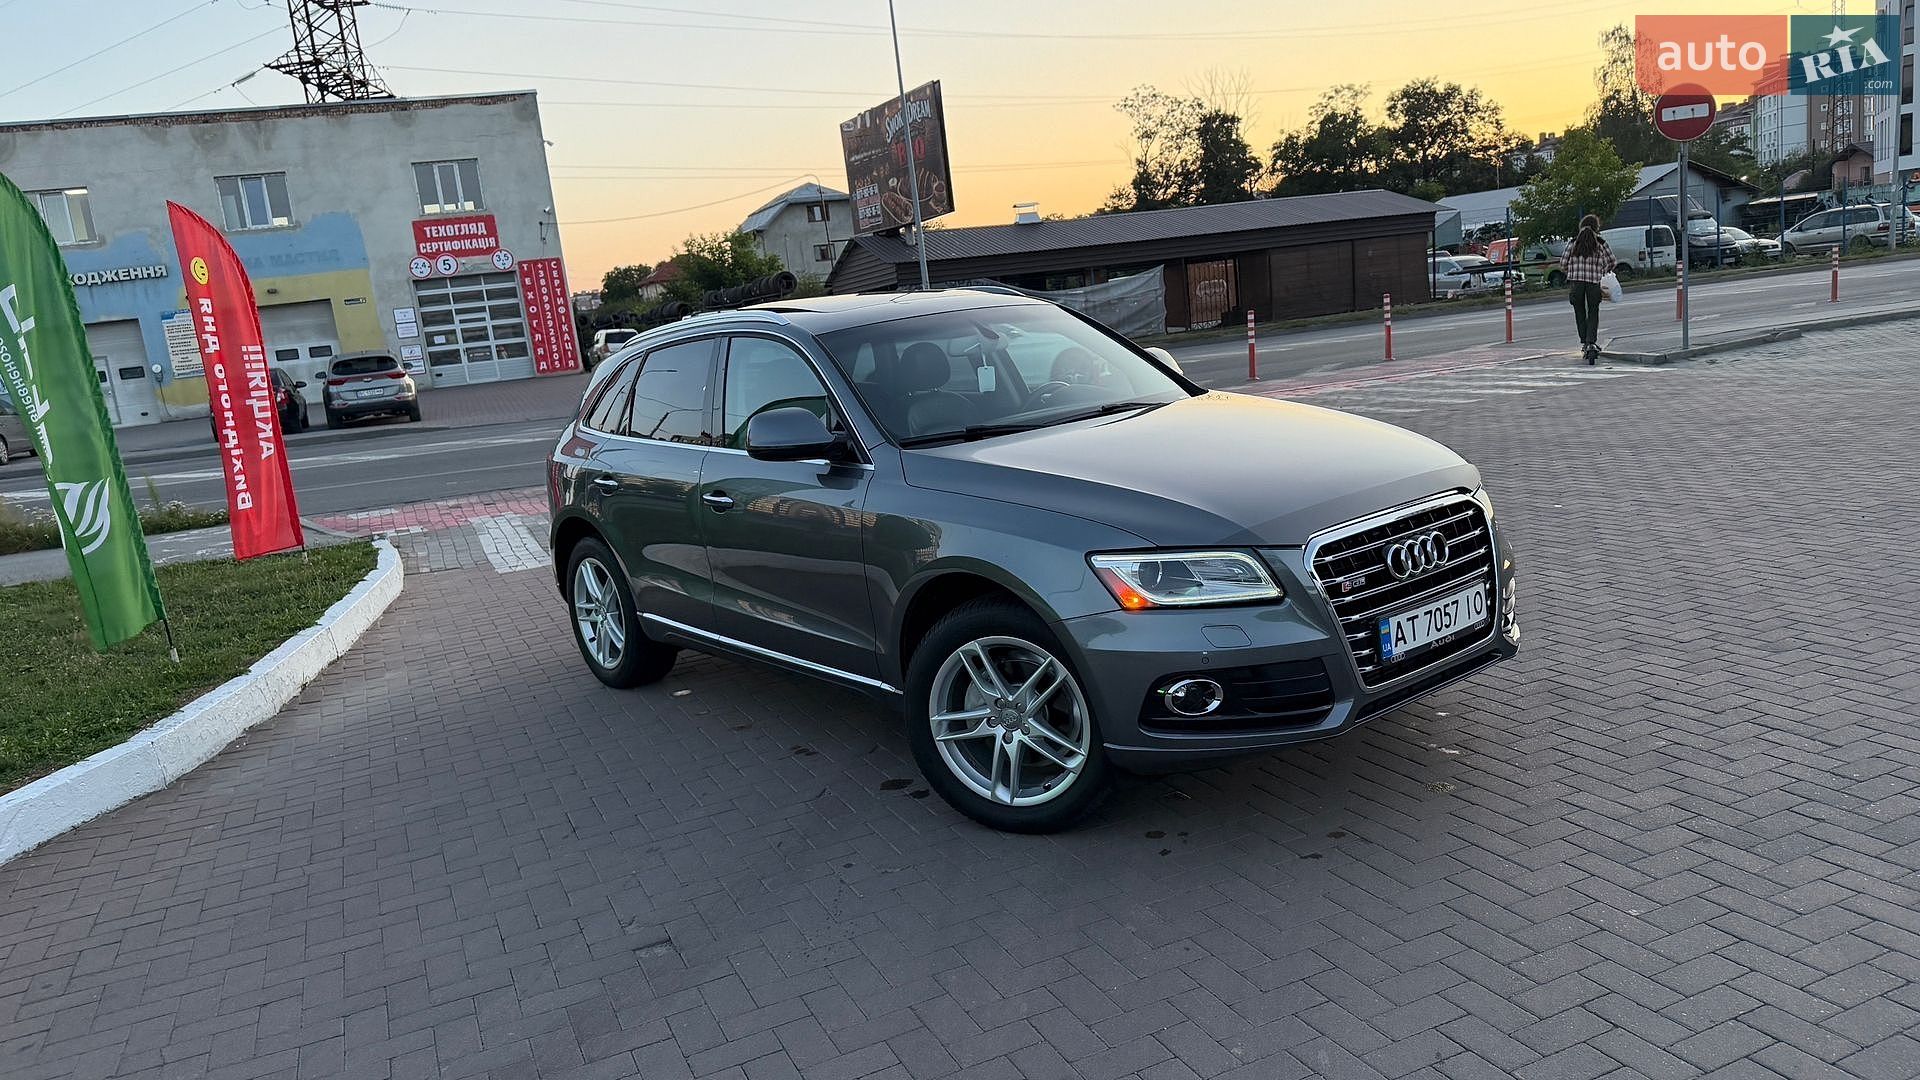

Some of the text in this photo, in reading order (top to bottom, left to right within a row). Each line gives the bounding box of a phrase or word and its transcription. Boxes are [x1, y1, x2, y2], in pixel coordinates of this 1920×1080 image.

[423, 222, 487, 238] ТЕХОГЛЯД
[419, 237, 496, 253] СЕРТИФІКАЦІЯ
[442, 258, 452, 271] 5
[522, 263, 548, 370] ТЕХОГЛЯД
[551, 261, 575, 368] СЕРТИФІКАЦІЯ
[1394, 591, 1483, 648] AT 7057 IO
[1382, 643, 1392, 652] UA
[1430, 634, 1456, 649] Audi
